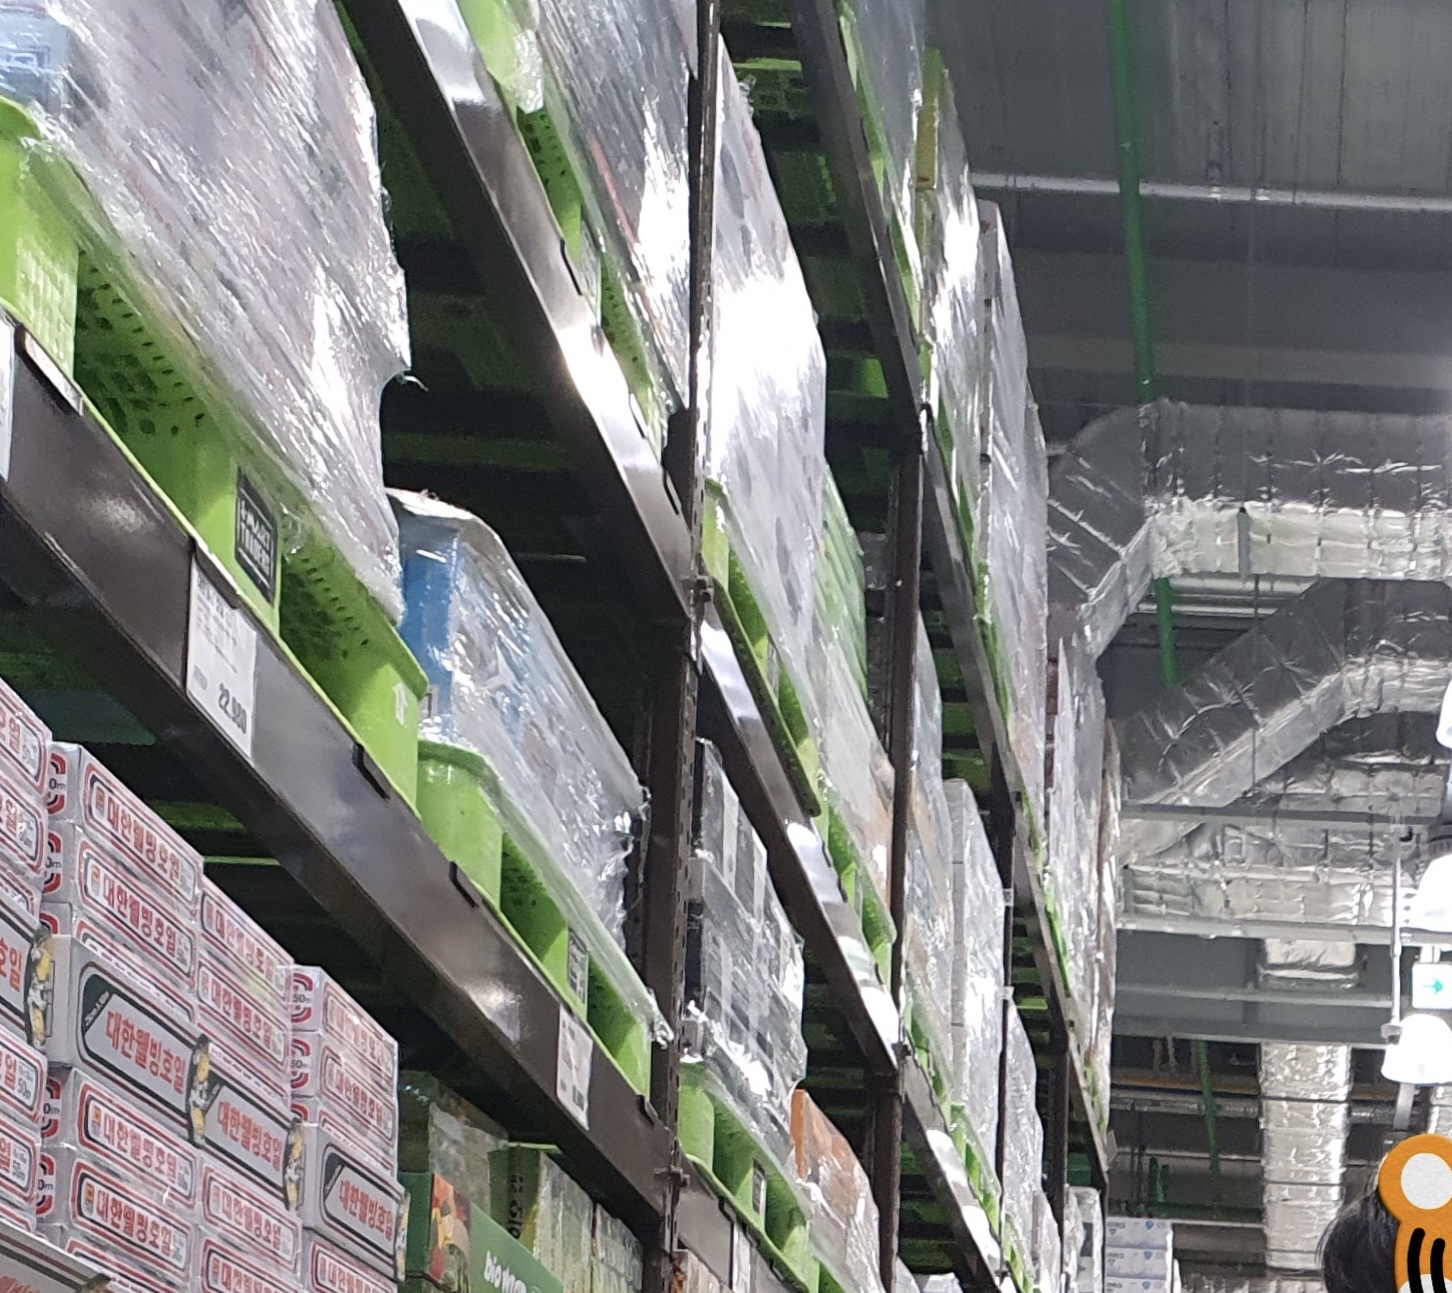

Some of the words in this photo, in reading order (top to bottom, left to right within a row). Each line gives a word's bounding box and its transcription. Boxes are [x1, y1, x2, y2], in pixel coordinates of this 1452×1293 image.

[107, 797, 182, 882] 대한웰빙호일
[103, 871, 177, 960] 대한웰빙호일
[106, 1010, 186, 1095] 대한웰빙호일
[103, 1112, 177, 1186] 대한웰빙호일
[217, 1101, 282, 1171] 대한웰빙호일
[97, 1188, 173, 1257] 대한웰빙호일
[222, 1189, 281, 1247] 대한웰빙호일
[339, 1179, 393, 1243] 대한웰빙호일
